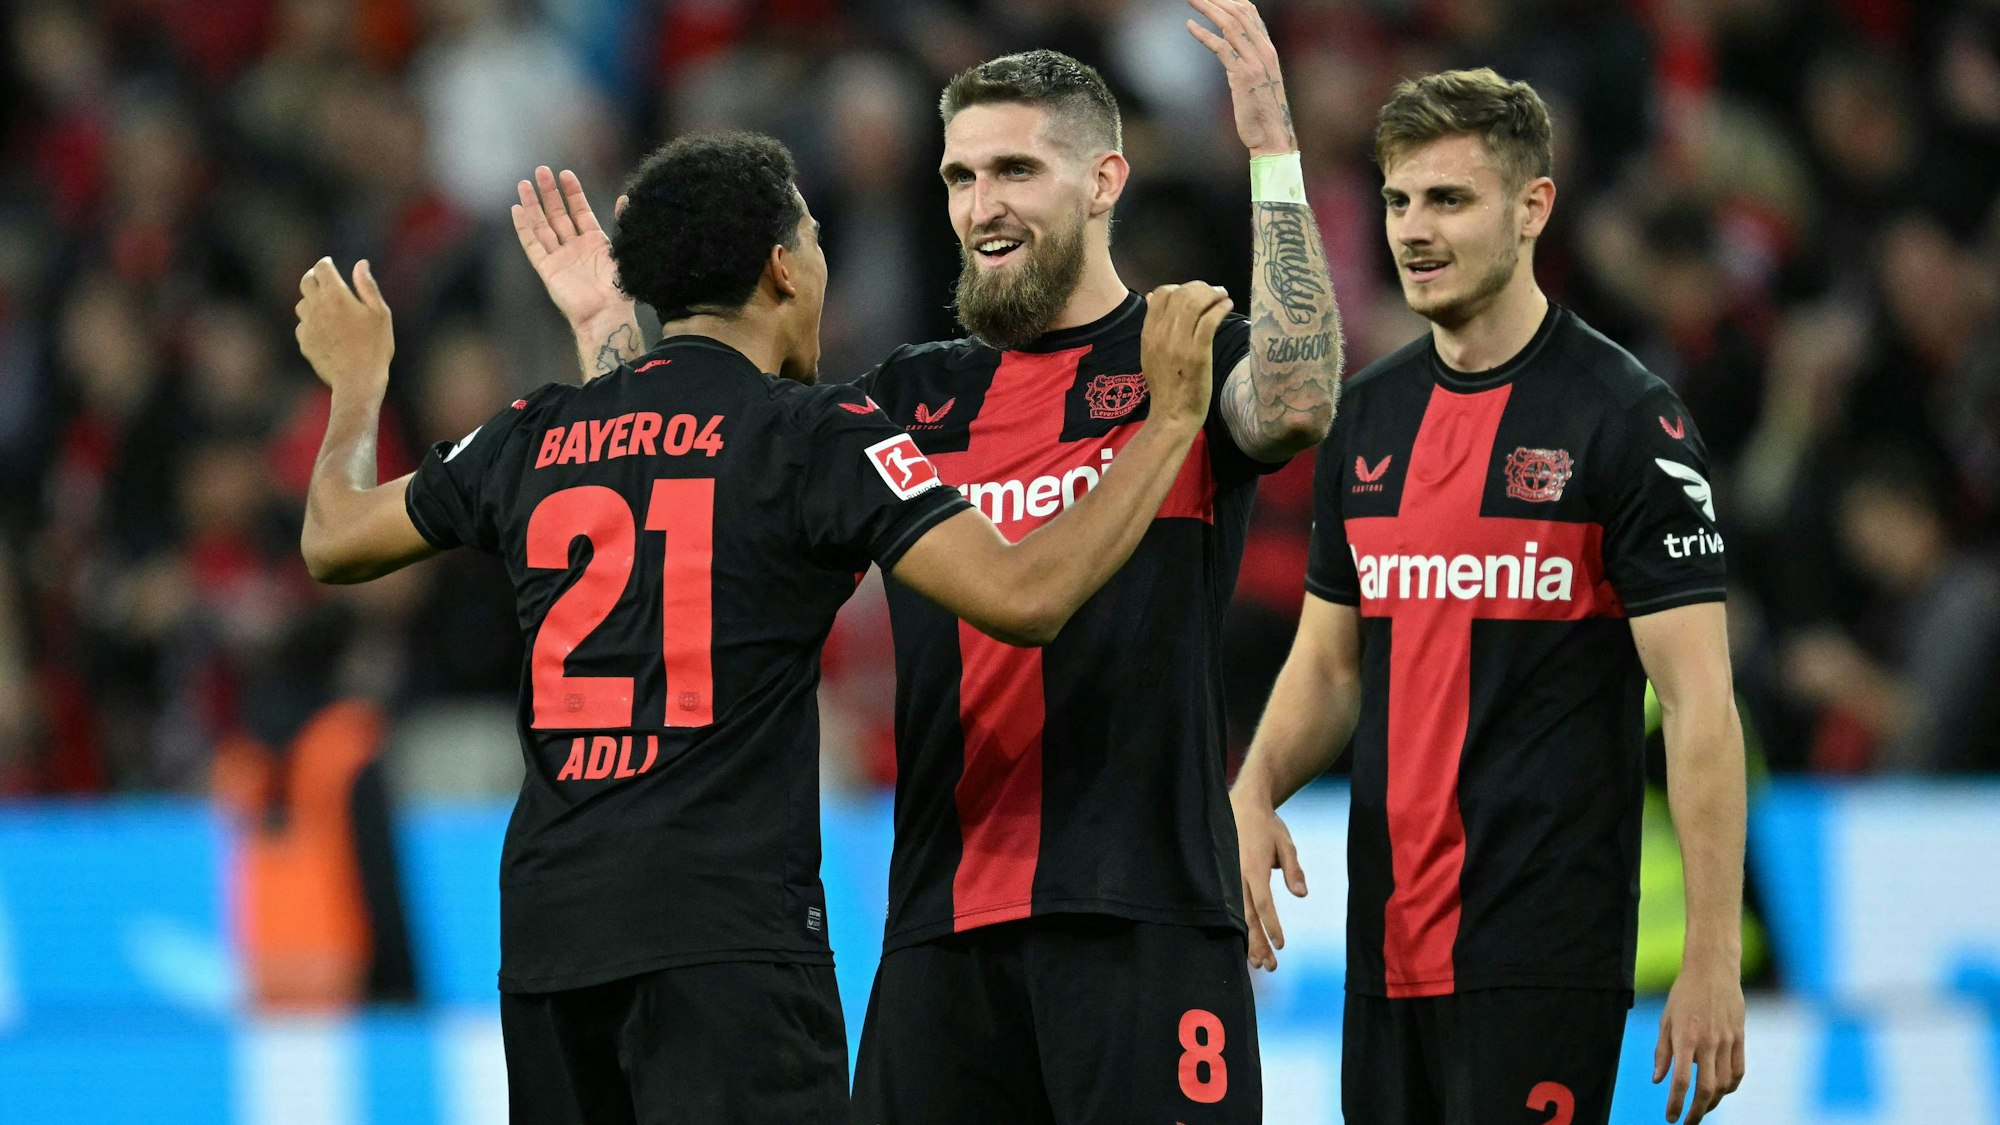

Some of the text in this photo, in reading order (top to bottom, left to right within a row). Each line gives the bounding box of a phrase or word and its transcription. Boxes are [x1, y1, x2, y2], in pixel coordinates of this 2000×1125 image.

[535, 411, 725, 469] BAYER 04
[526, 477, 716, 729] 21
[1349, 541, 1574, 601] armenia
[1178, 1007, 1228, 1104] 8
